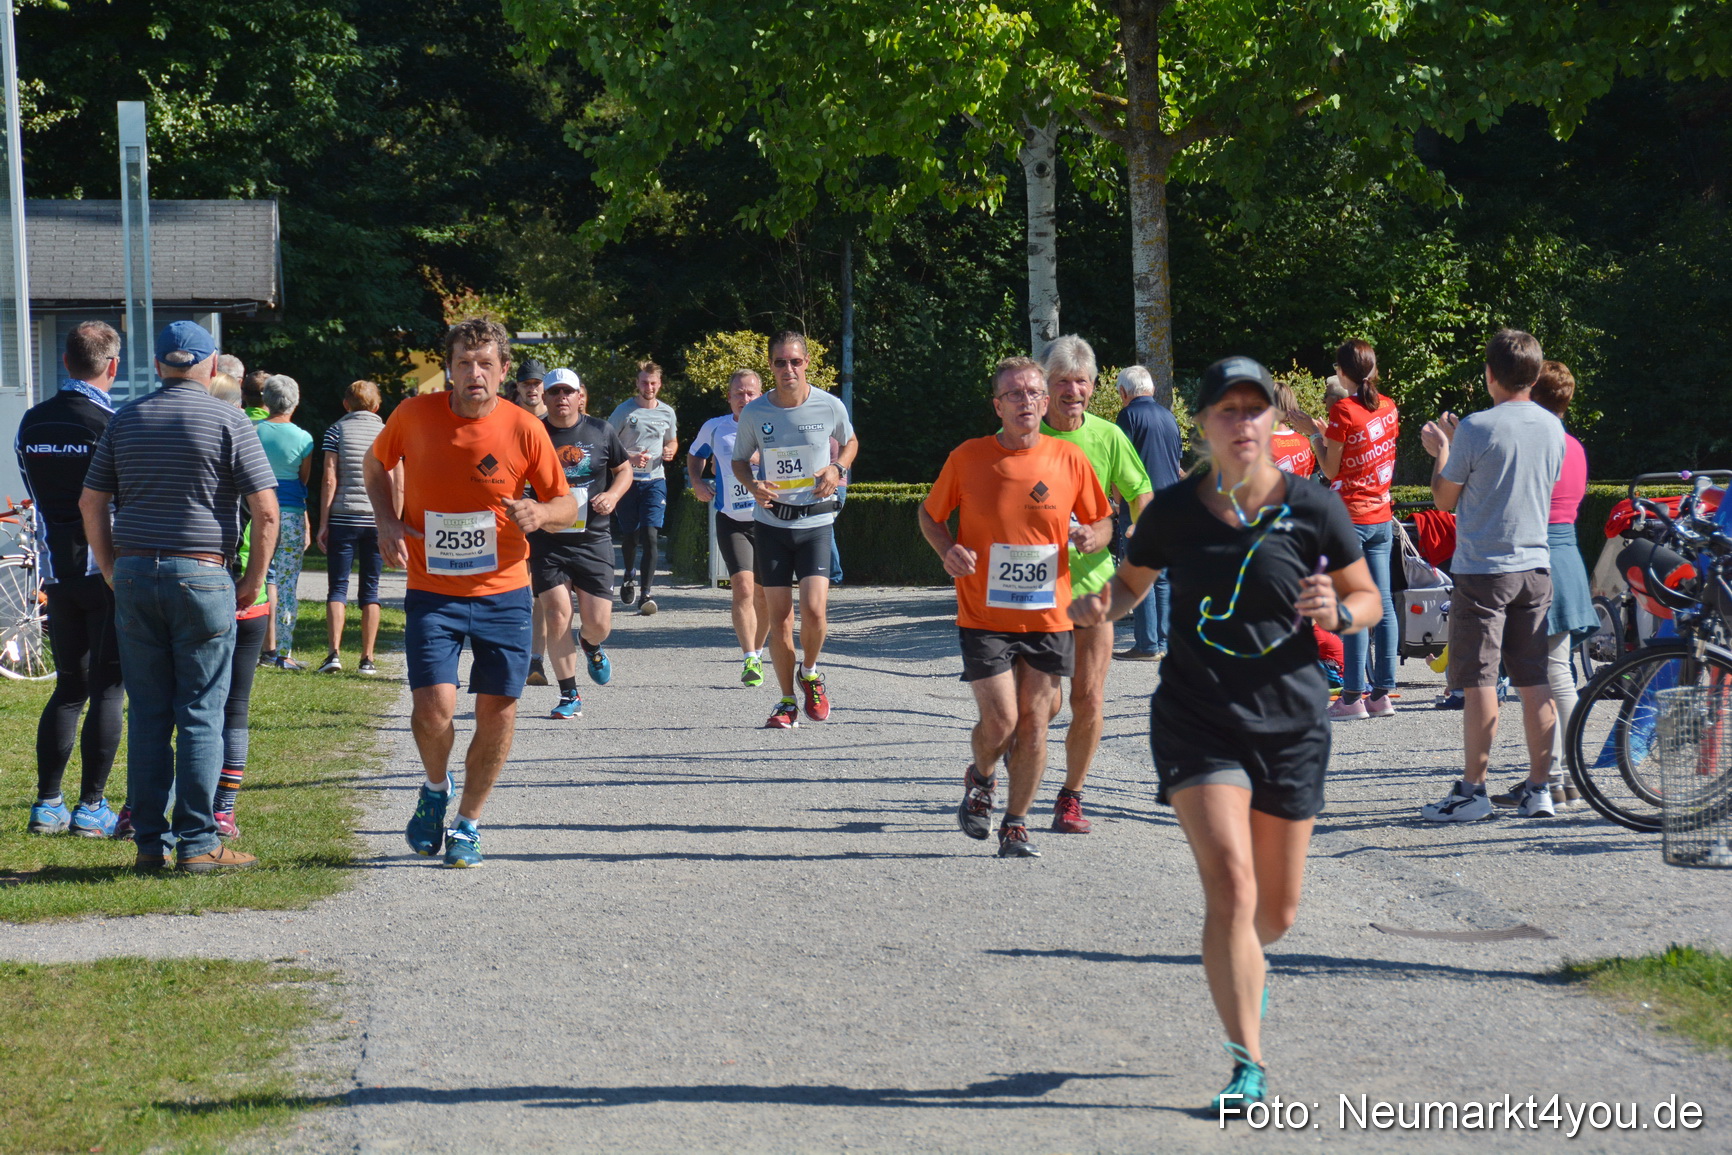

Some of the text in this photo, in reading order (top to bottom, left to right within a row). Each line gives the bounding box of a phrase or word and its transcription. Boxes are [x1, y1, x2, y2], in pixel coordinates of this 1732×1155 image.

[798, 423, 824, 431] BOCK
[1273, 438, 1301, 448] Team
[776, 458, 803, 475] 354
[435, 529, 486, 550] 2538
[450, 560, 474, 569] Franz
[998, 562, 1048, 582] 2536
[1010, 593, 1034, 602] Franz
